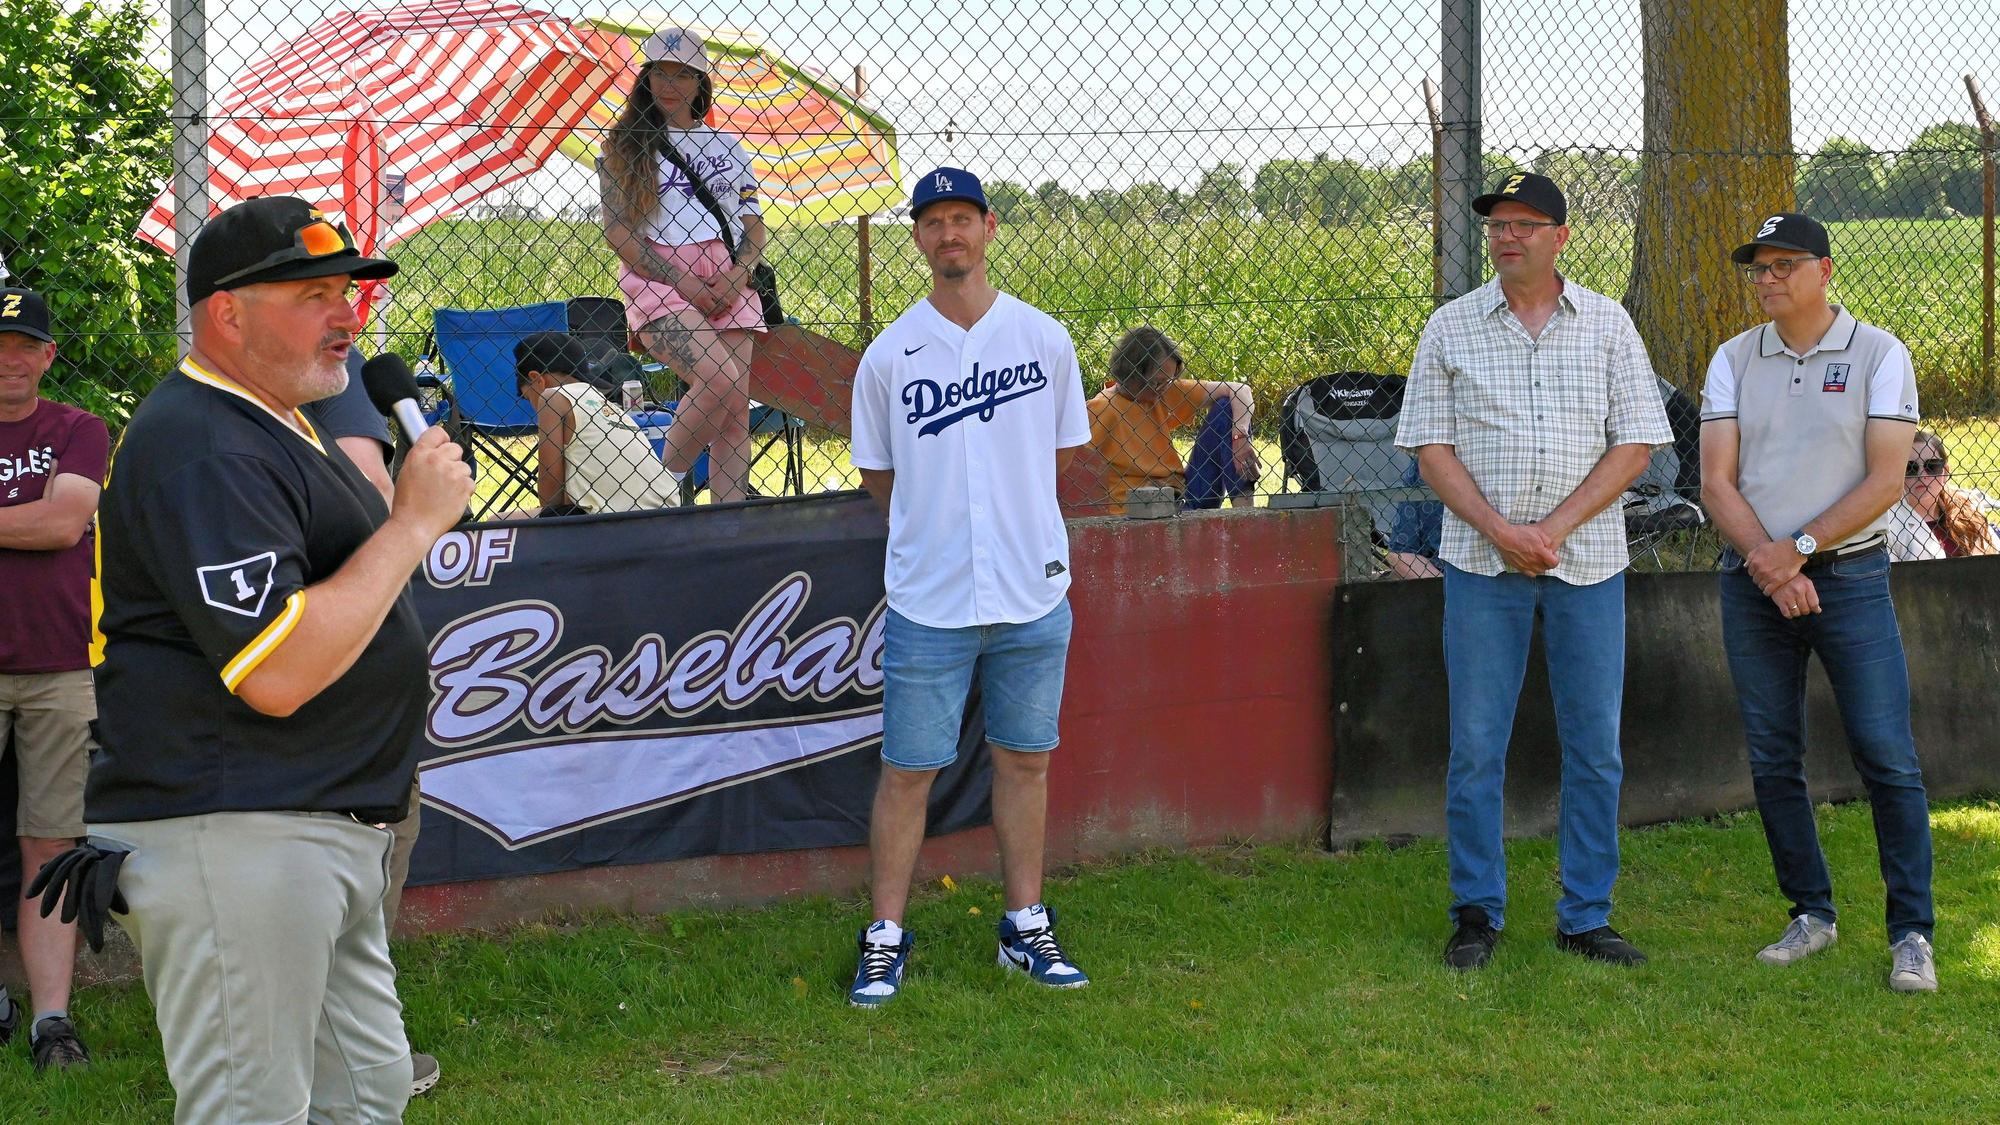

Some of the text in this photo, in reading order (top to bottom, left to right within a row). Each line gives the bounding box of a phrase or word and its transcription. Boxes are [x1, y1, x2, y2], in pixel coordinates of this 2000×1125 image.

[934, 172, 953, 193] LA
[1503, 174, 1526, 195] Z
[2, 294, 23, 318] Z
[902, 361, 1047, 425] Dodgers
[425, 528, 516, 589] OF
[230, 568, 257, 602] 1
